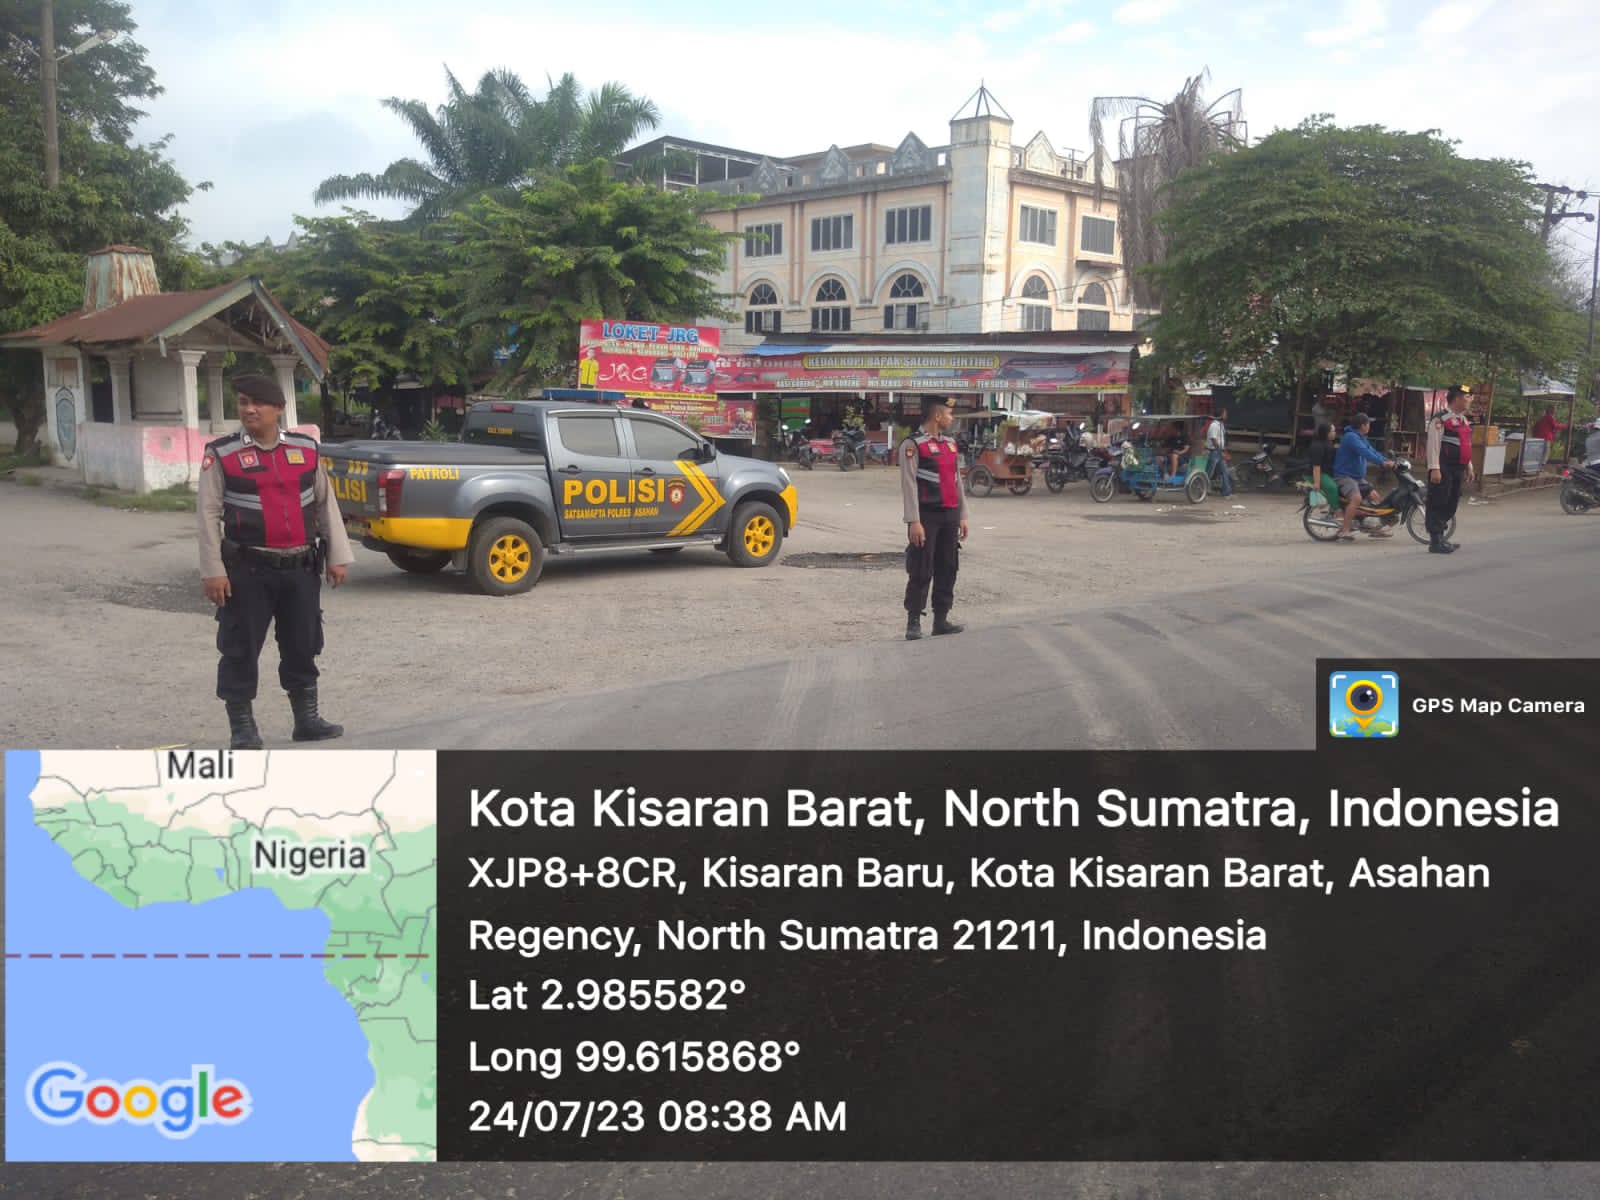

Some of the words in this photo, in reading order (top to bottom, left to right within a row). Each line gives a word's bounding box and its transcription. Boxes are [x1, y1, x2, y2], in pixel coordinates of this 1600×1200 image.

[603, 322, 661, 341] LOKET
[665, 327, 699, 344] JRG
[599, 362, 648, 383] JRG
[409, 467, 460, 480] PATROLI
[329, 476, 367, 503] LISI
[563, 478, 665, 505] POLISI
[607, 507, 631, 519] POLRES
[634, 506, 659, 517] ASAHAN
